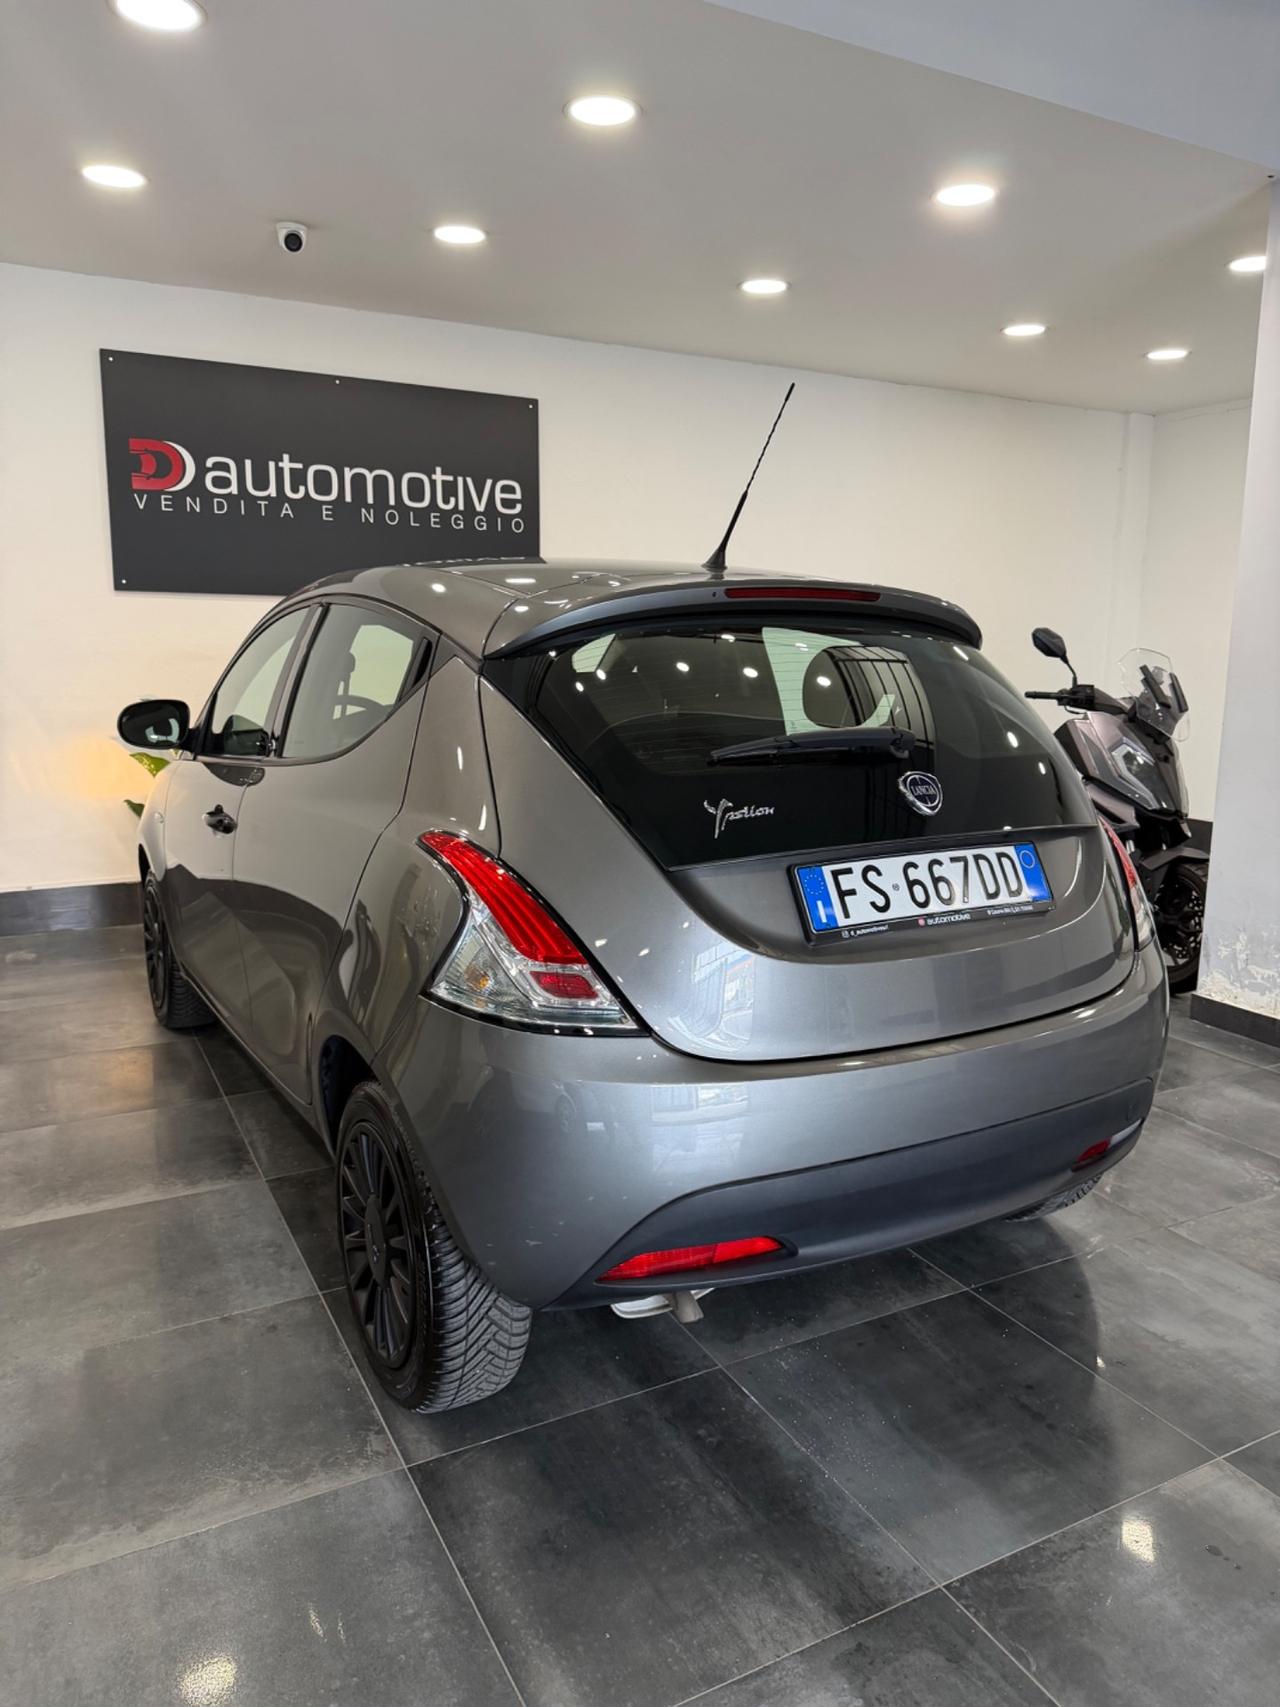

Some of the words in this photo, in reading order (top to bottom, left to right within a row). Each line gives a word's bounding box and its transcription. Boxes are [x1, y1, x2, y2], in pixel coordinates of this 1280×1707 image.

[204, 453, 523, 515] automotive
[133, 494, 294, 519] VENDITA
[322, 505, 334, 521] E
[361, 508, 525, 534] NOLEGGIO
[910, 784, 937, 798] LANCIA
[703, 797, 776, 840] Ypsilon
[829, 863, 892, 920] FS
[902, 851, 1024, 909] 667DD
[926, 912, 972, 926] automotive
